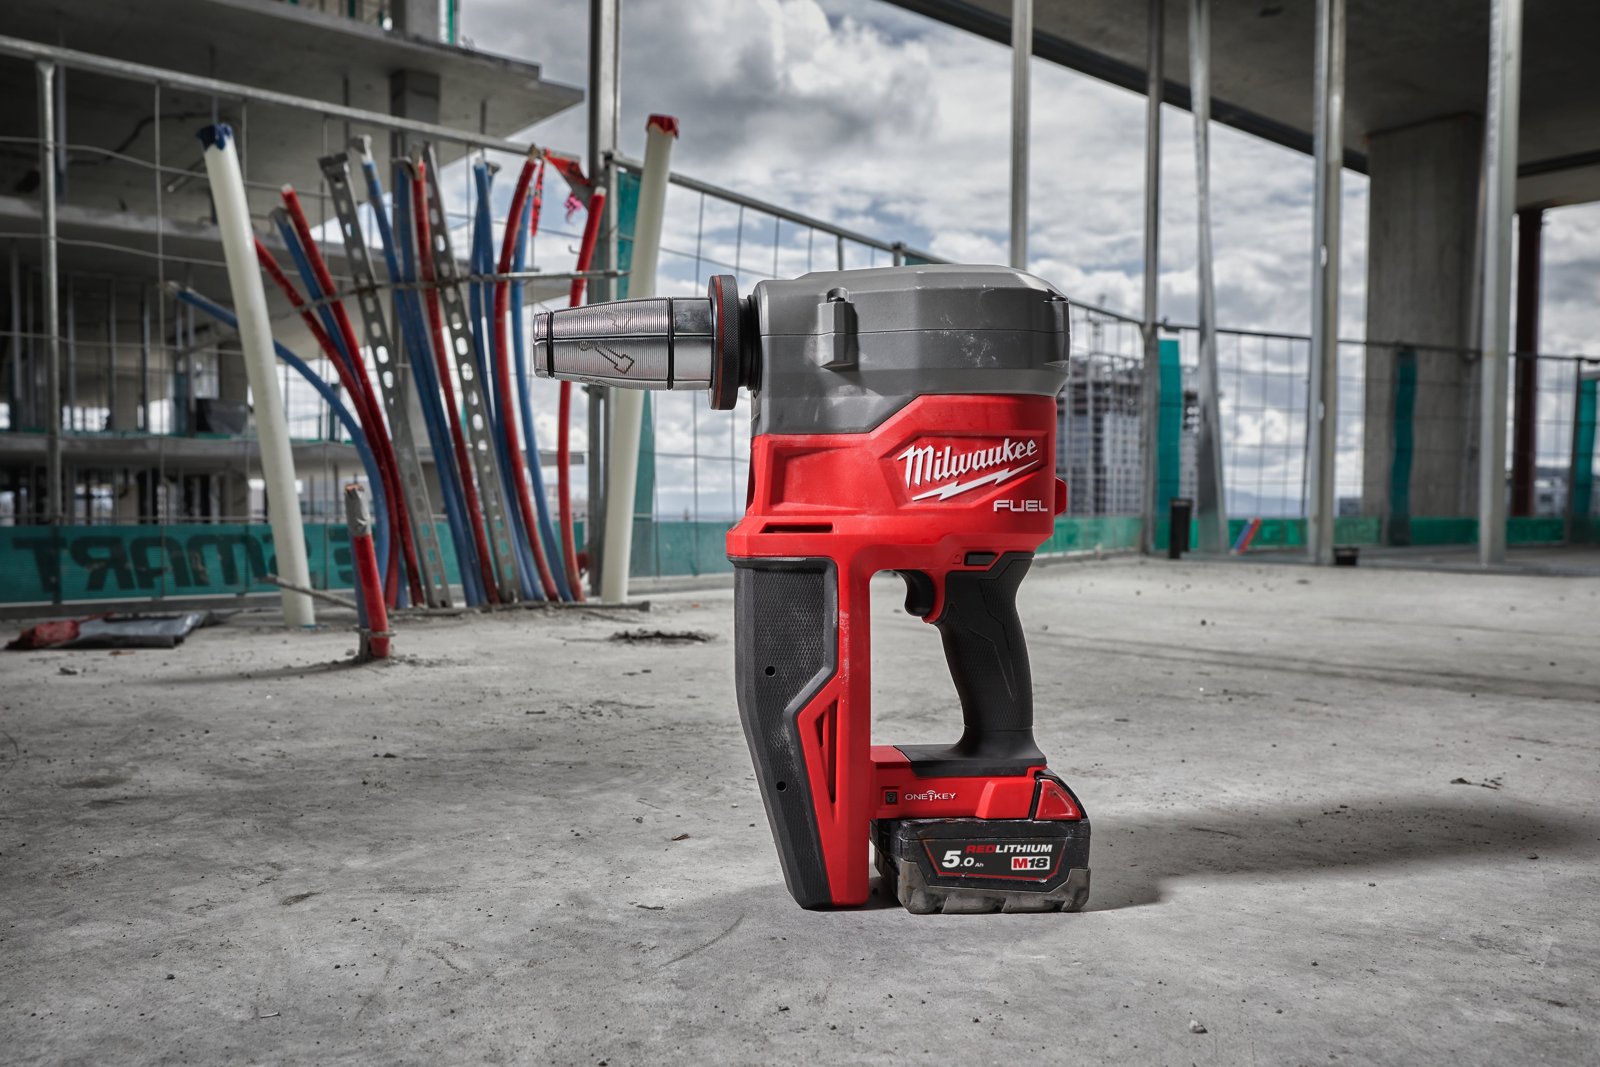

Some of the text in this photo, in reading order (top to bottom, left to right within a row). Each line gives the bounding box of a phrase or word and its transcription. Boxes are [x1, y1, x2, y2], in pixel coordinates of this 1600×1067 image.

[897, 438, 1037, 488] Milwaukee
[994, 499, 1048, 512] FUEL
[965, 844, 1053, 854] REDLITHIUM
[941, 850, 975, 868] 5.0
[1012, 857, 1050, 869] M18
